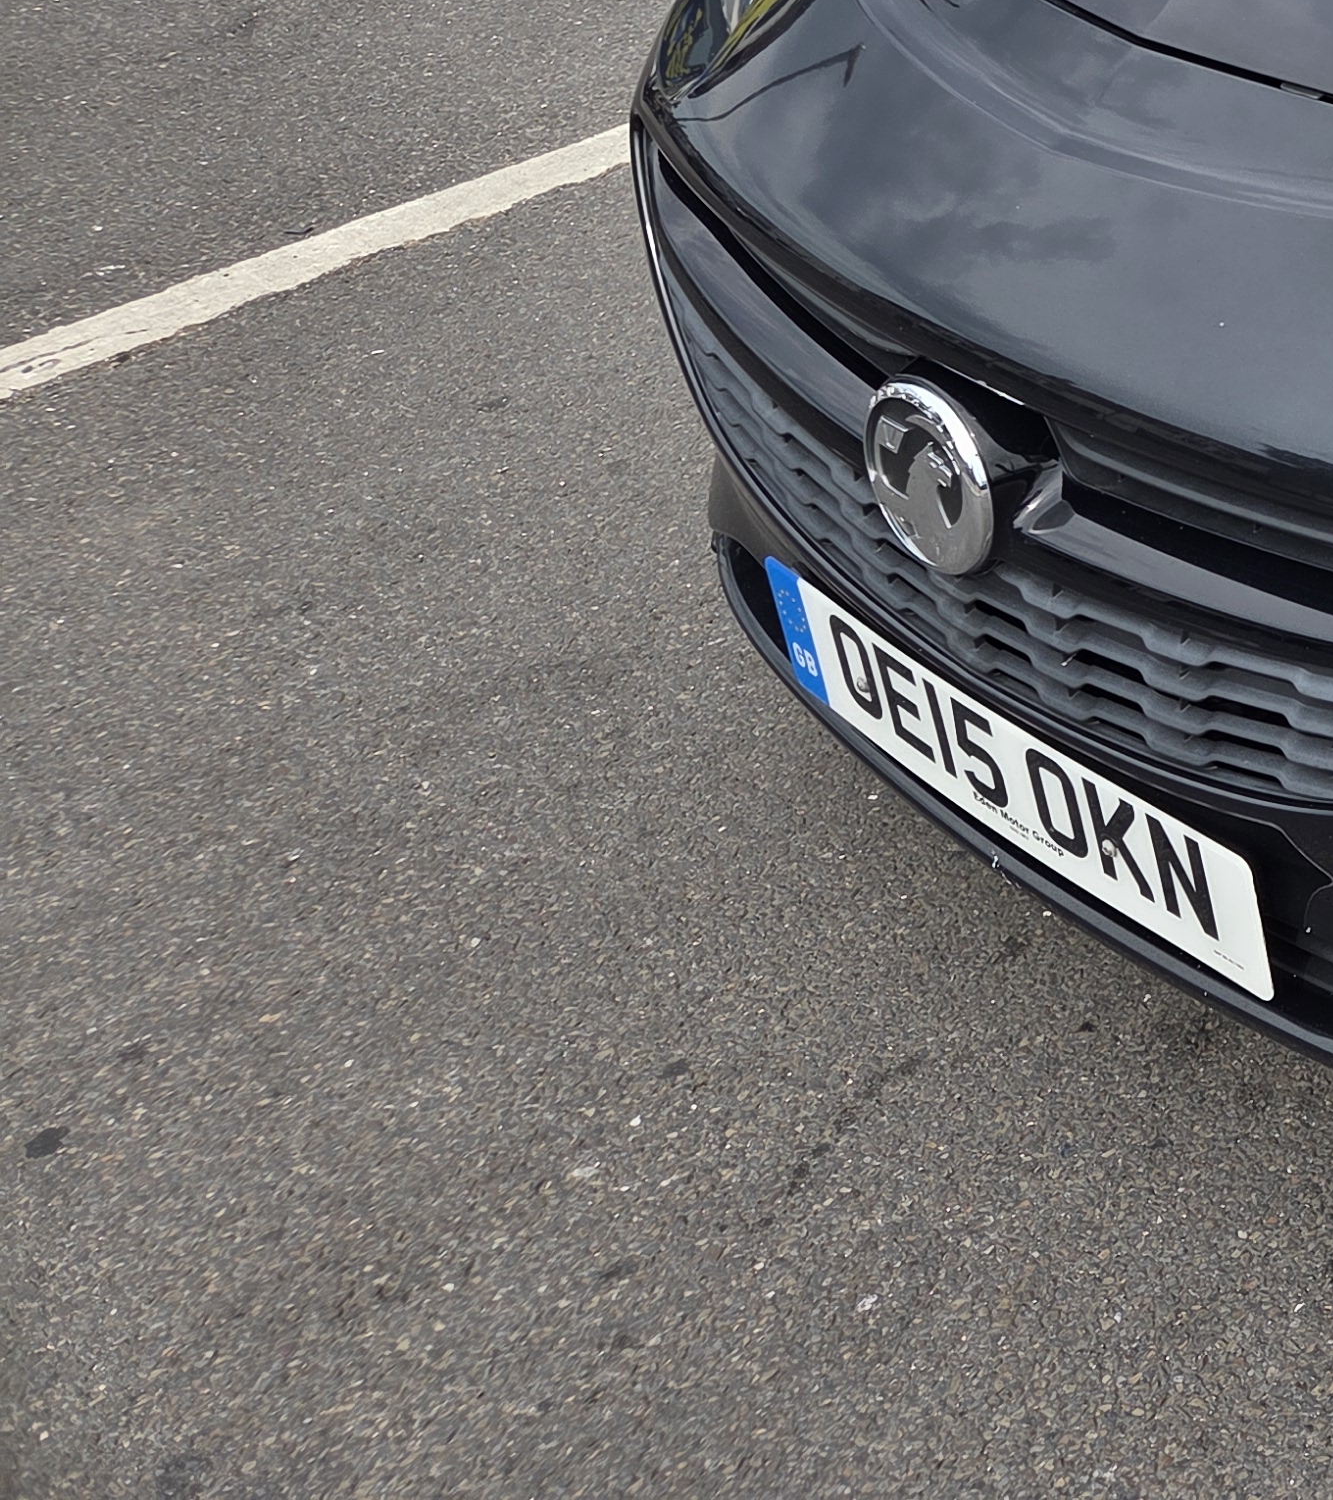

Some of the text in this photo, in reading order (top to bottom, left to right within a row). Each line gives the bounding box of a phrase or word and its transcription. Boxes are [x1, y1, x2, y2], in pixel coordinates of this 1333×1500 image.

[791, 640, 819, 678] GB
[829, 613, 1220, 942] OE15 OKN
[973, 790, 998, 814] Eden
[1000, 808, 1030, 833] Motor
[1032, 829, 1064, 858] Group
